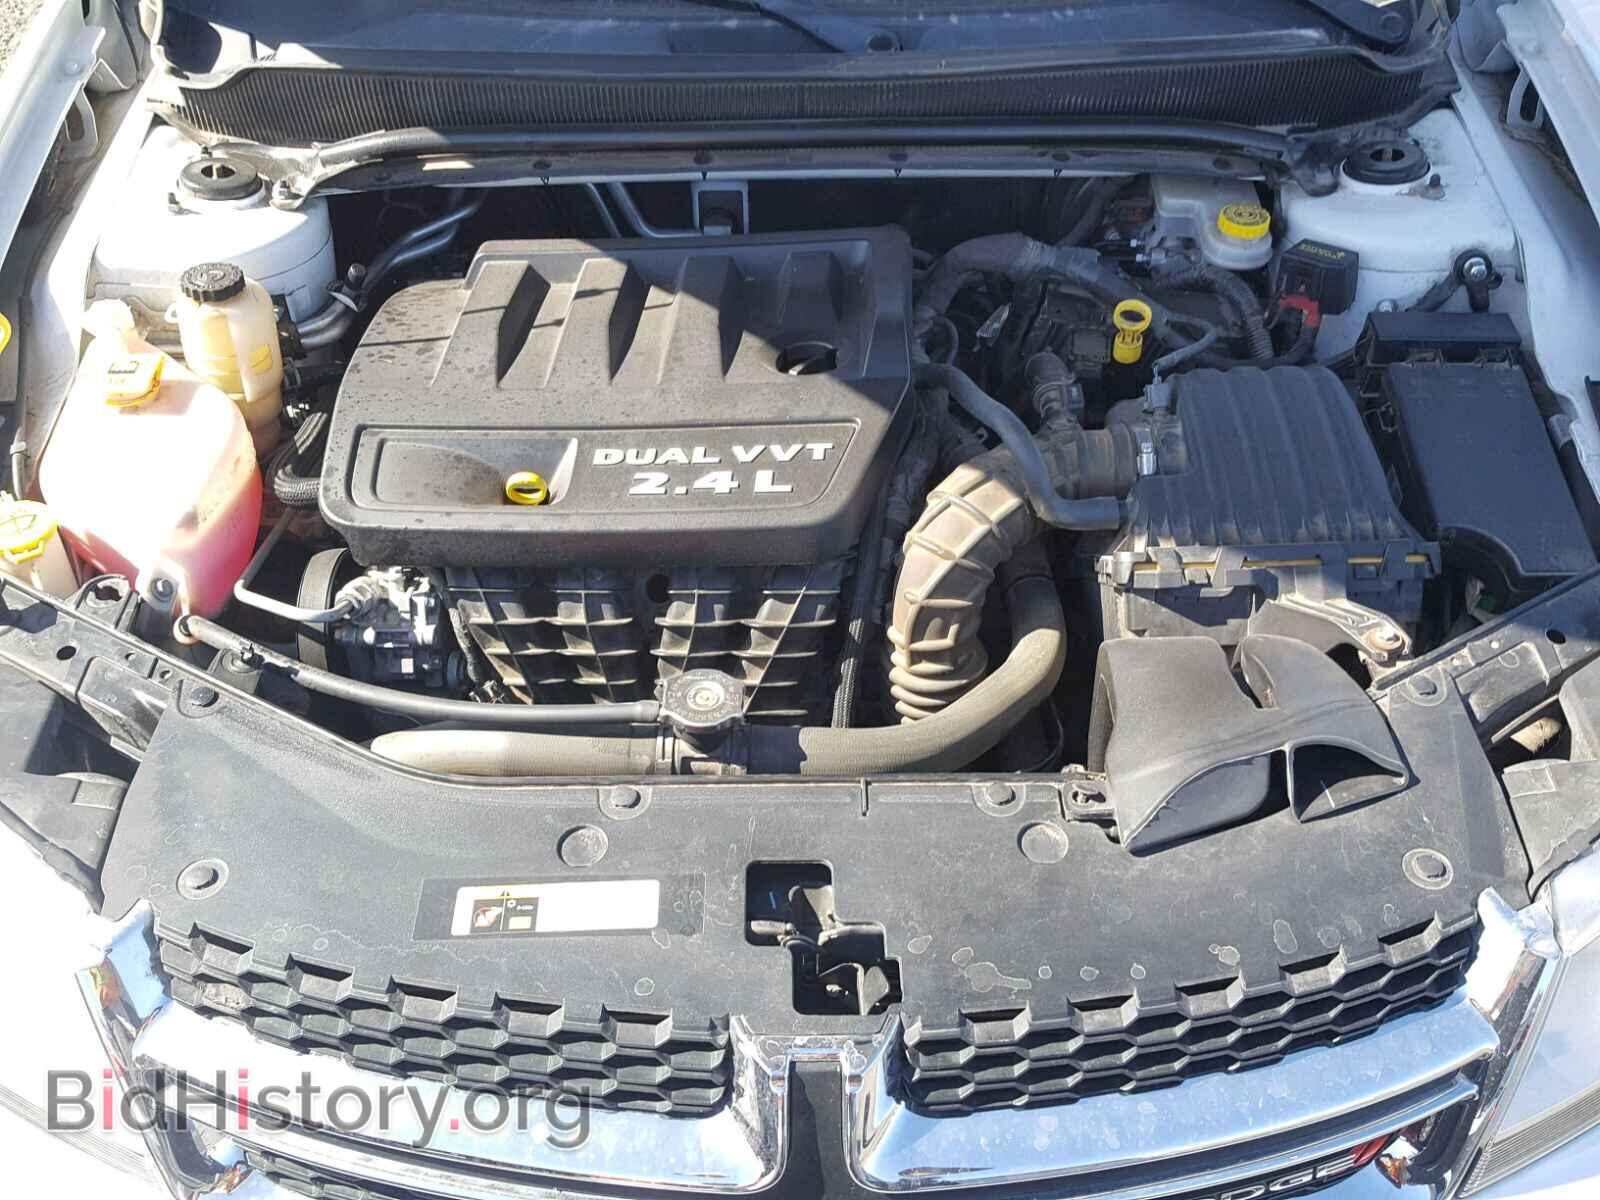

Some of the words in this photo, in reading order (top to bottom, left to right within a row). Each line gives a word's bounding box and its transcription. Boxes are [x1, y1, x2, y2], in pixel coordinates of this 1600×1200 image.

[592, 446, 721, 466] DUAL
[732, 442, 834, 463] VVT
[628, 470, 740, 496] 2.4
[754, 469, 794, 494] L
